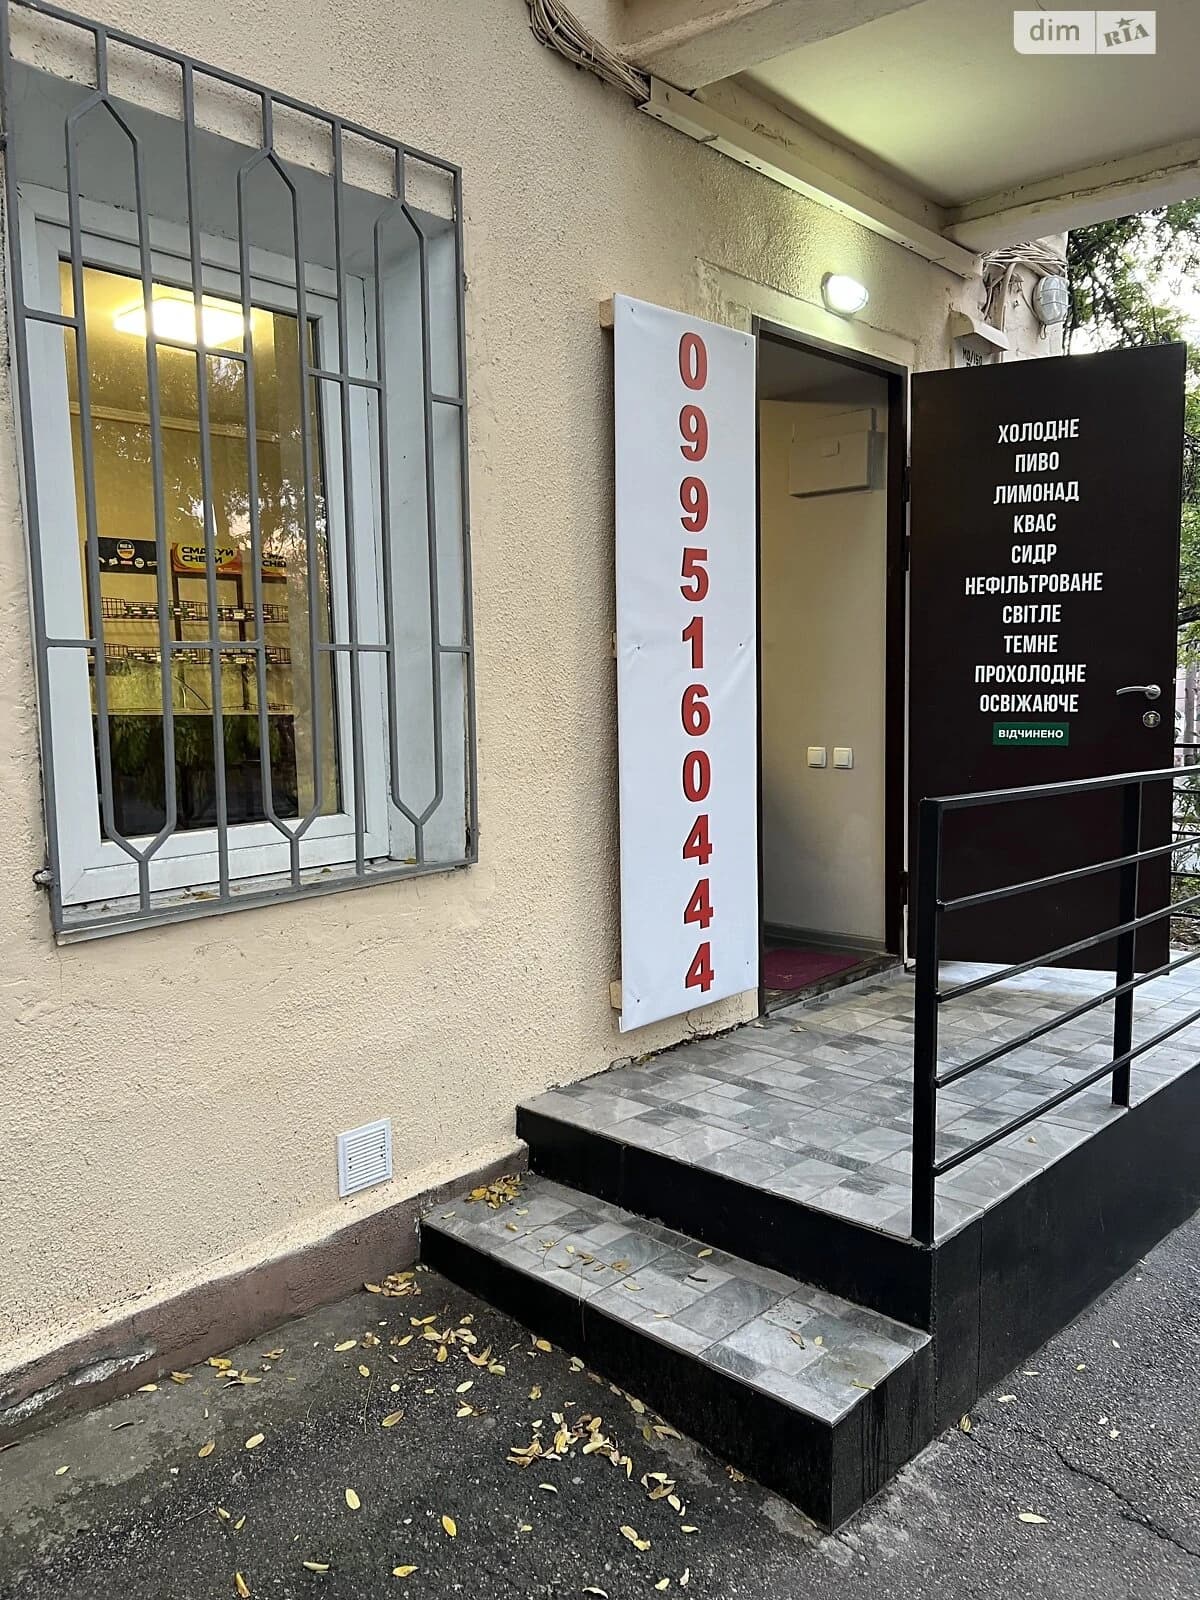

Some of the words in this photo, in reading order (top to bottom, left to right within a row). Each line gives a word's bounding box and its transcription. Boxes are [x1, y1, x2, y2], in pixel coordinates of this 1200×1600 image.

[997, 418, 1080, 443] ХОЛОДНЕ
[1015, 451, 1060, 473] ПИВО
[993, 480, 1080, 505] ЛИМОНАД
[1013, 512, 1057, 534] КВАС
[182, 554, 223, 564] СНЕИ
[1011, 543, 1057, 565] СИДР
[965, 572, 1103, 596] НЕФІЛЬТРОВАНЕ
[1002, 603, 1062, 624] СВІТЛЕ
[1003, 634, 1059, 654] ТЕМНЕ
[679, 332, 715, 992] 0995160444
[974, 663, 1087, 685] ПРОХОЛОДНЕ
[979, 693, 1080, 713] ОСВІЖАЮЧЕ
[998, 729, 1064, 741] ВІДЧИНЕНО
